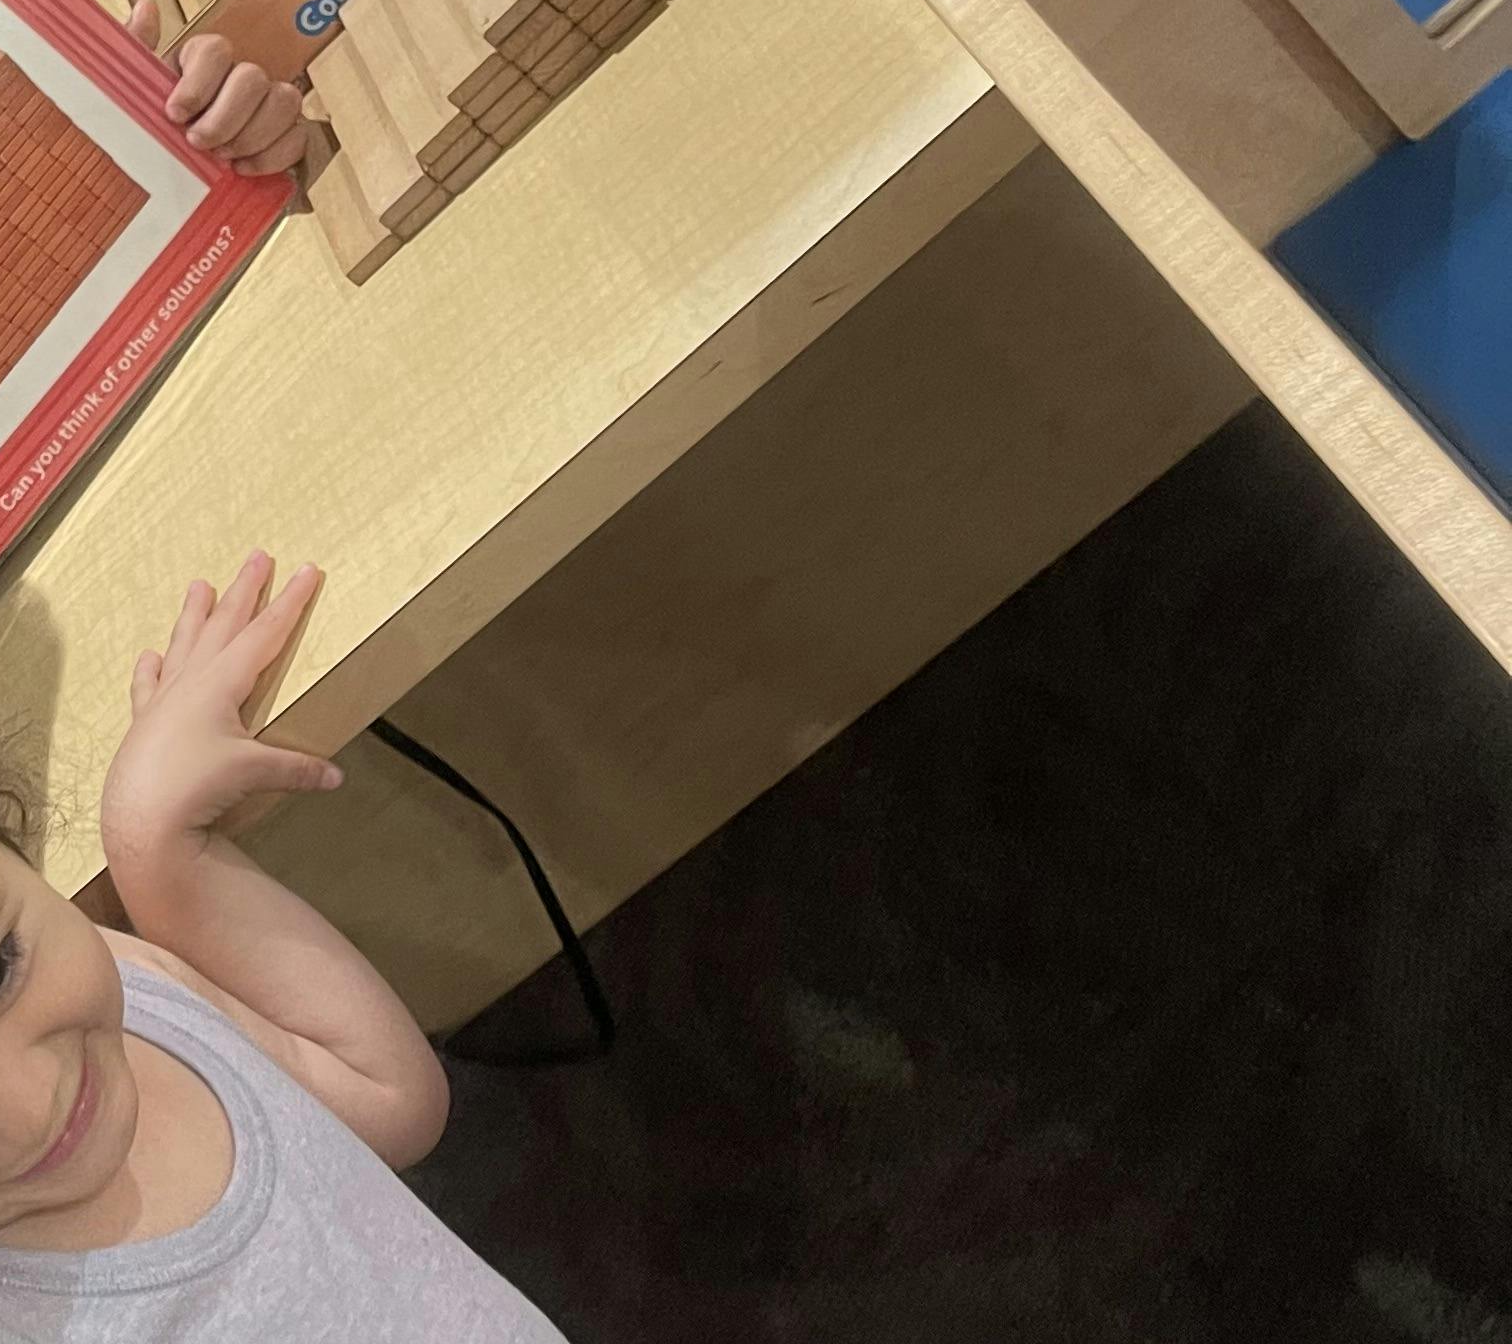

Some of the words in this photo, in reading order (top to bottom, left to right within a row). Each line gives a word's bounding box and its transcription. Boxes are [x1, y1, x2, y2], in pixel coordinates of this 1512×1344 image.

[30, 442, 62, 479] you
[59, 392, 104, 441] think
[100, 367, 121, 394] of
[118, 323, 160, 371] other
[158, 225, 236, 322] solutions?
